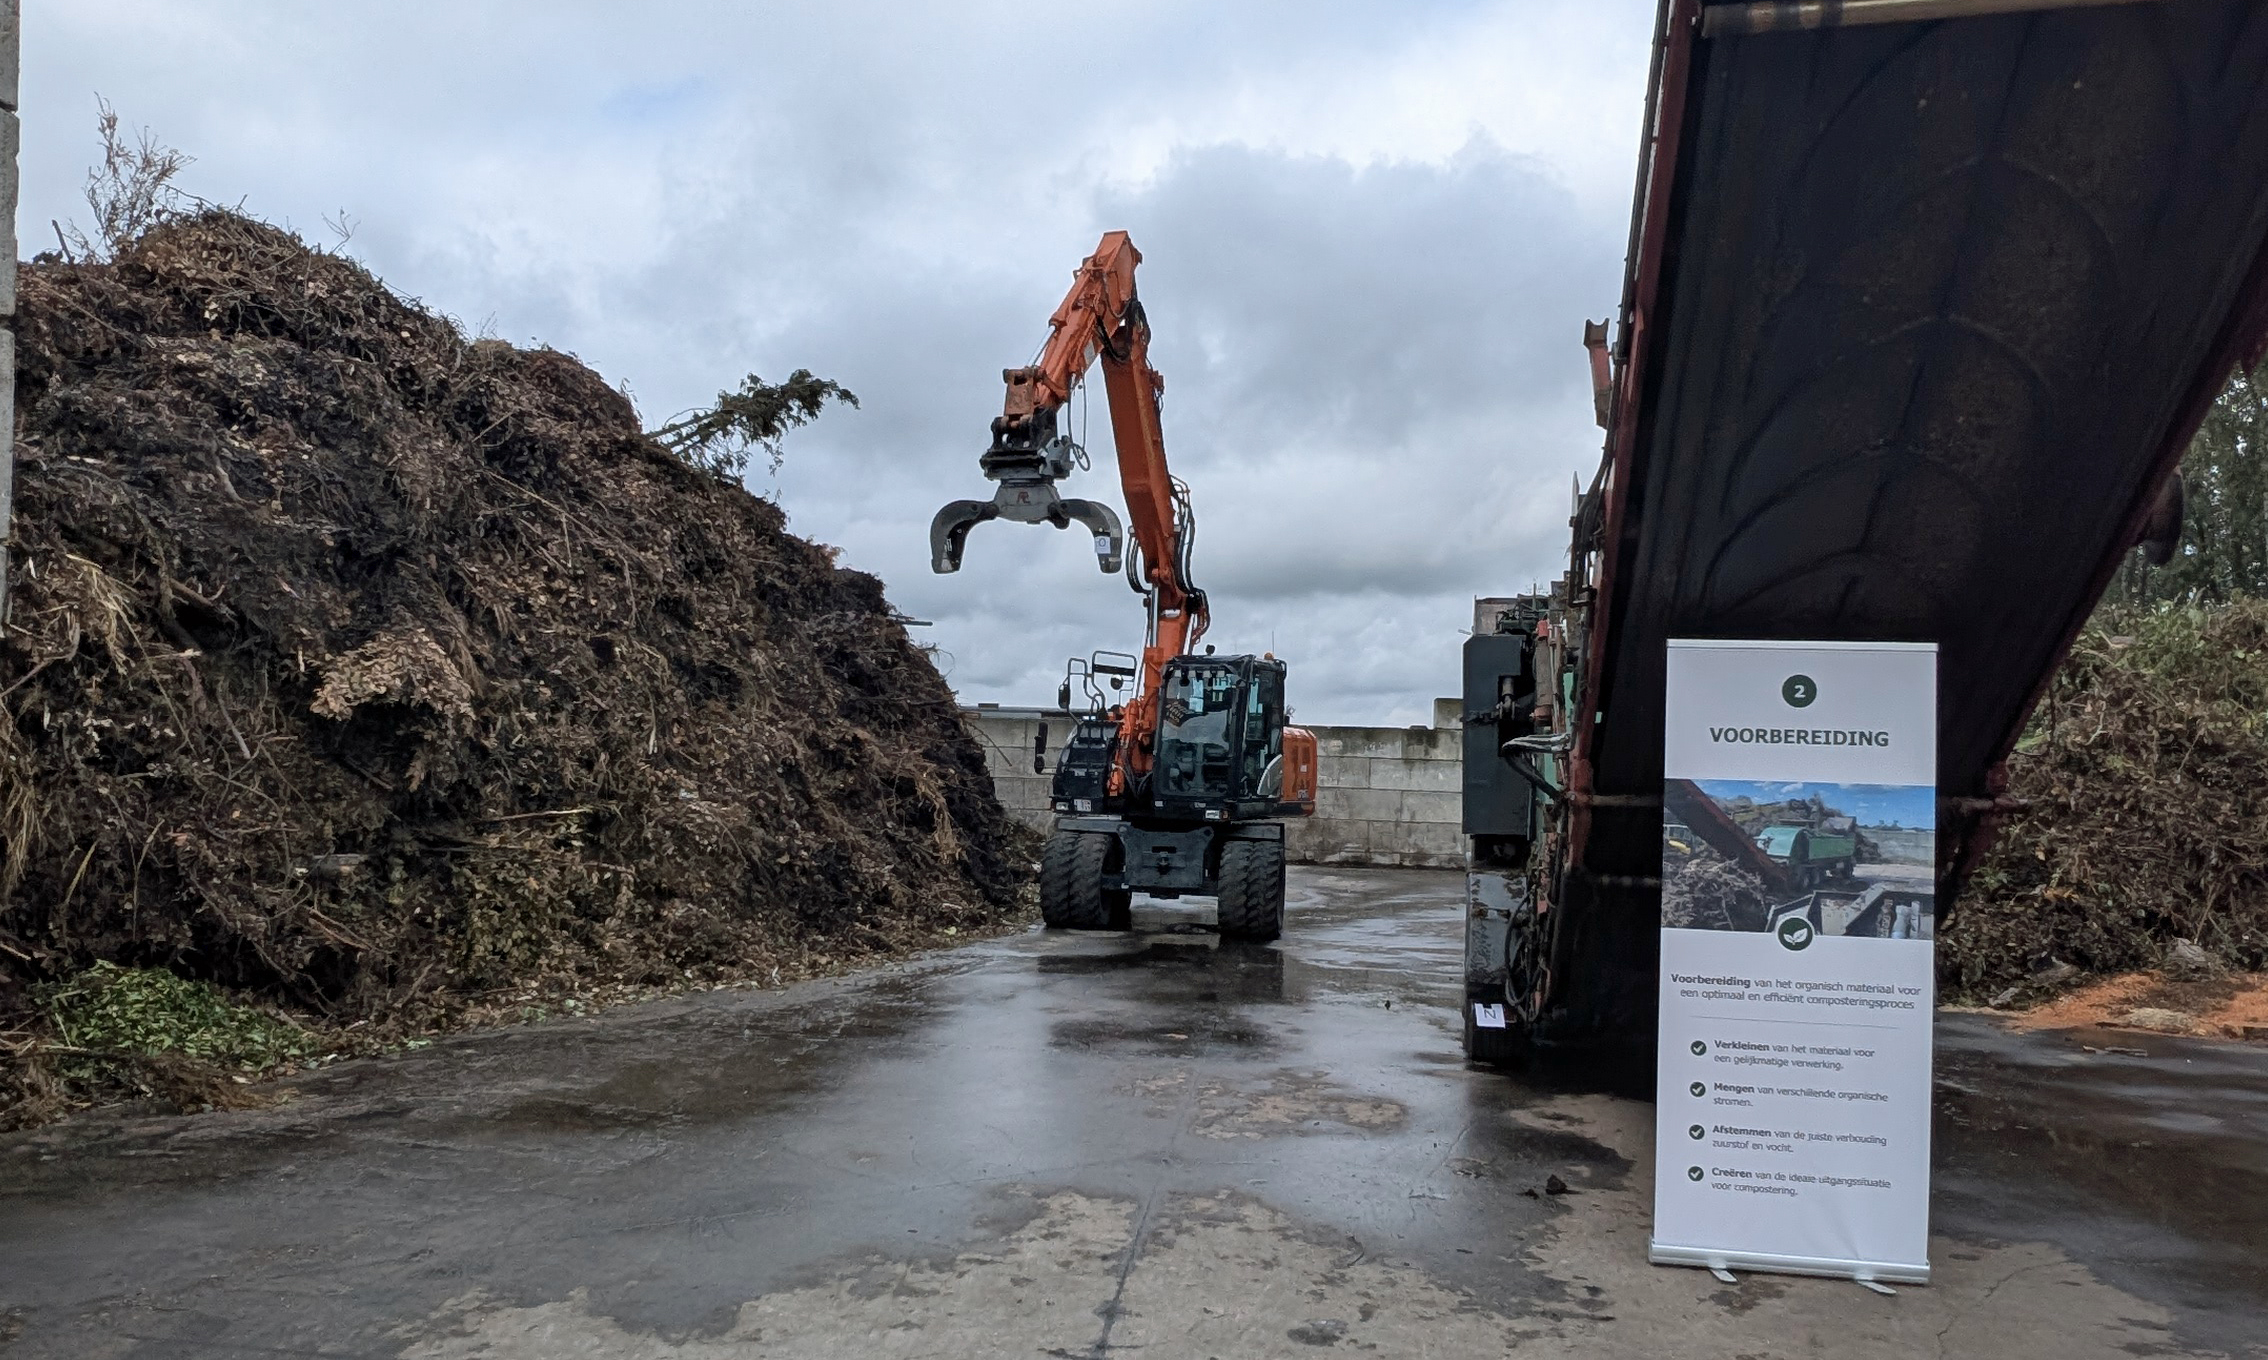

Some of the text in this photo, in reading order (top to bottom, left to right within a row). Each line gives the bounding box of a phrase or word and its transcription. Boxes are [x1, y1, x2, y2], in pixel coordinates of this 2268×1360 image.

[1794, 684, 1806, 698] 2
[1709, 727, 1889, 747] VOORBEREIDING
[1671, 973, 1921, 995] Voorbereiding van het organisch materiaal voor
[1680, 989, 1915, 1009] een optimaal en efficiënt composteringsproces
[1714, 1039, 1875, 1058] Verkleinen van het materiaal voor
[1714, 1054, 1731, 1063] een
[1733, 1055, 1789, 1068] gelijkmatige
[1714, 1082, 1889, 1102] Mengen van verschillende organische
[1712, 1125, 1772, 1137] Afstemmen
[1774, 1130, 1791, 1139] van
[1793, 1130, 1805, 1140] de
[1836, 1133, 1887, 1147] verhouding
[1752, 1142, 1763, 1150] en
[1711, 1167, 1752, 1178] Creëren
[1755, 1172, 1772, 1180] van
[1774, 1172, 1786, 1181] de
[1711, 1182, 1732, 1190] voor
